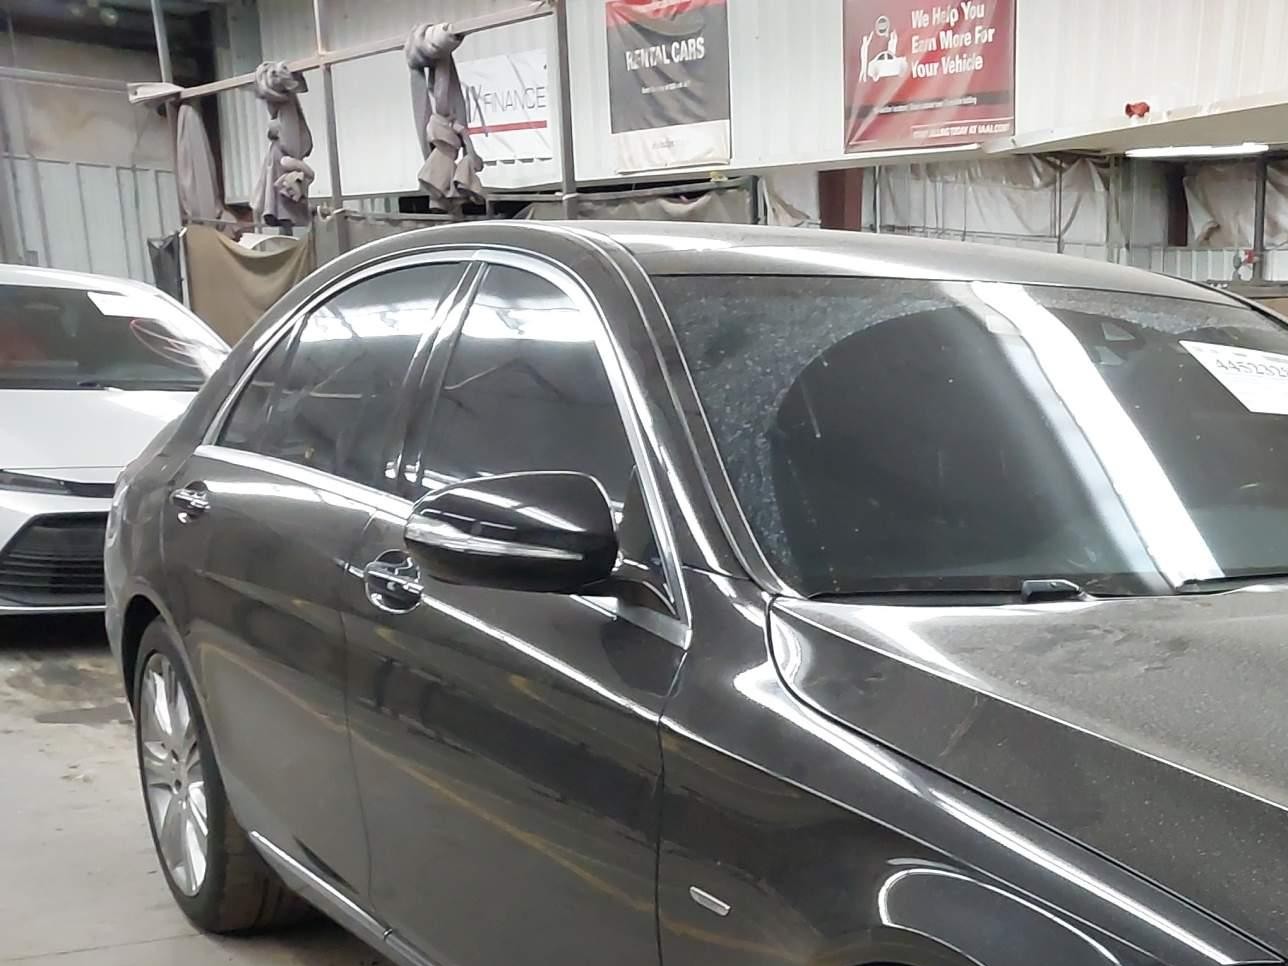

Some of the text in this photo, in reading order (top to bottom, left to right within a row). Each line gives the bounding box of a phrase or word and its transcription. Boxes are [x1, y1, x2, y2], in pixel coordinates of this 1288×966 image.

[911, 1, 985, 29] We Help You
[625, 37, 705, 71] RENTAL CARS
[911, 26, 995, 54] Earn More For
[911, 54, 983, 79] Your Vehicle
[483, 86, 547, 113] FINANCE
